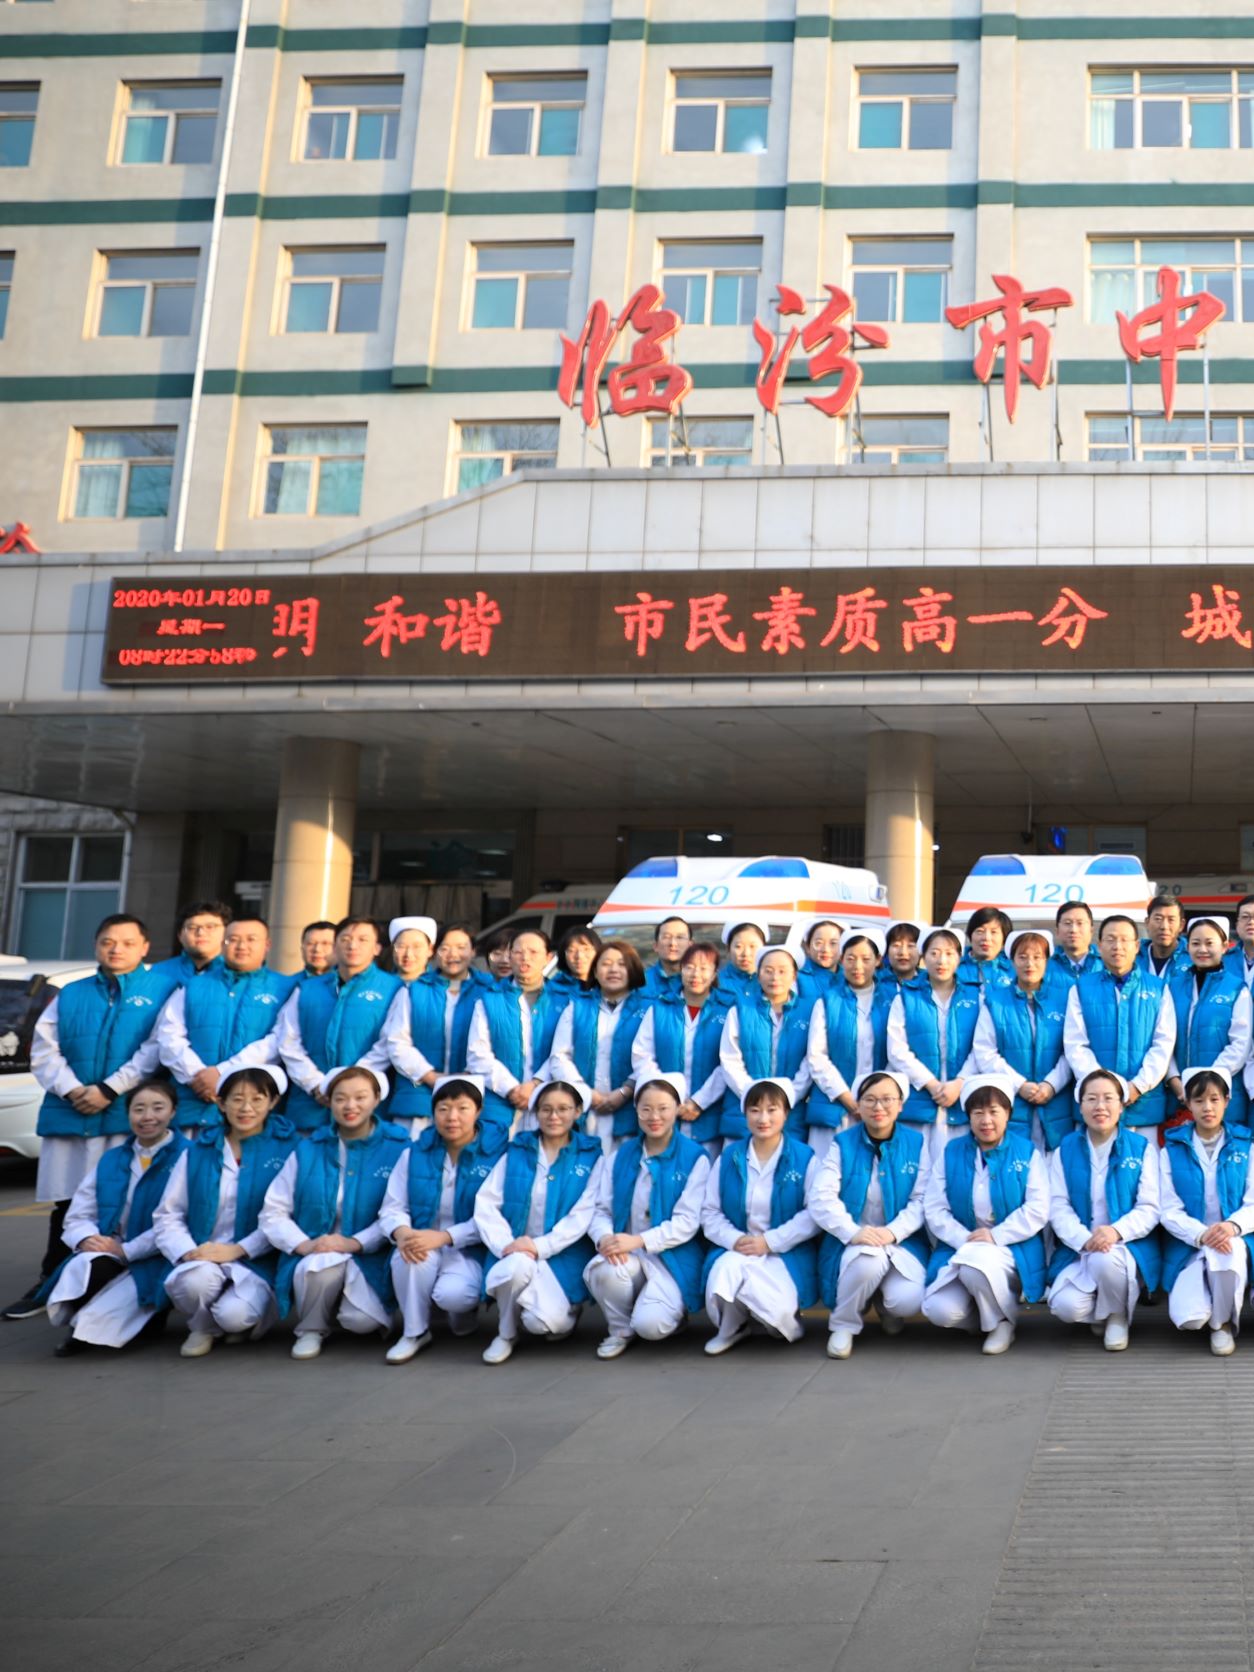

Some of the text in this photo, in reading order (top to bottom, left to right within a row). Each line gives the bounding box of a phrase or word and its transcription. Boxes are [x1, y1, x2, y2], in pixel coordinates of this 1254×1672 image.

[112, 587, 271, 608] 2020年01月20日
[156, 618, 226, 636] 星期一
[362, 591, 503, 659] 和谐
[613, 585, 1109, 657] 市民素质高一分
[668, 885, 730, 906] 120
[1024, 883, 1084, 903] 120
[1157, 884, 1182, 897] 20
